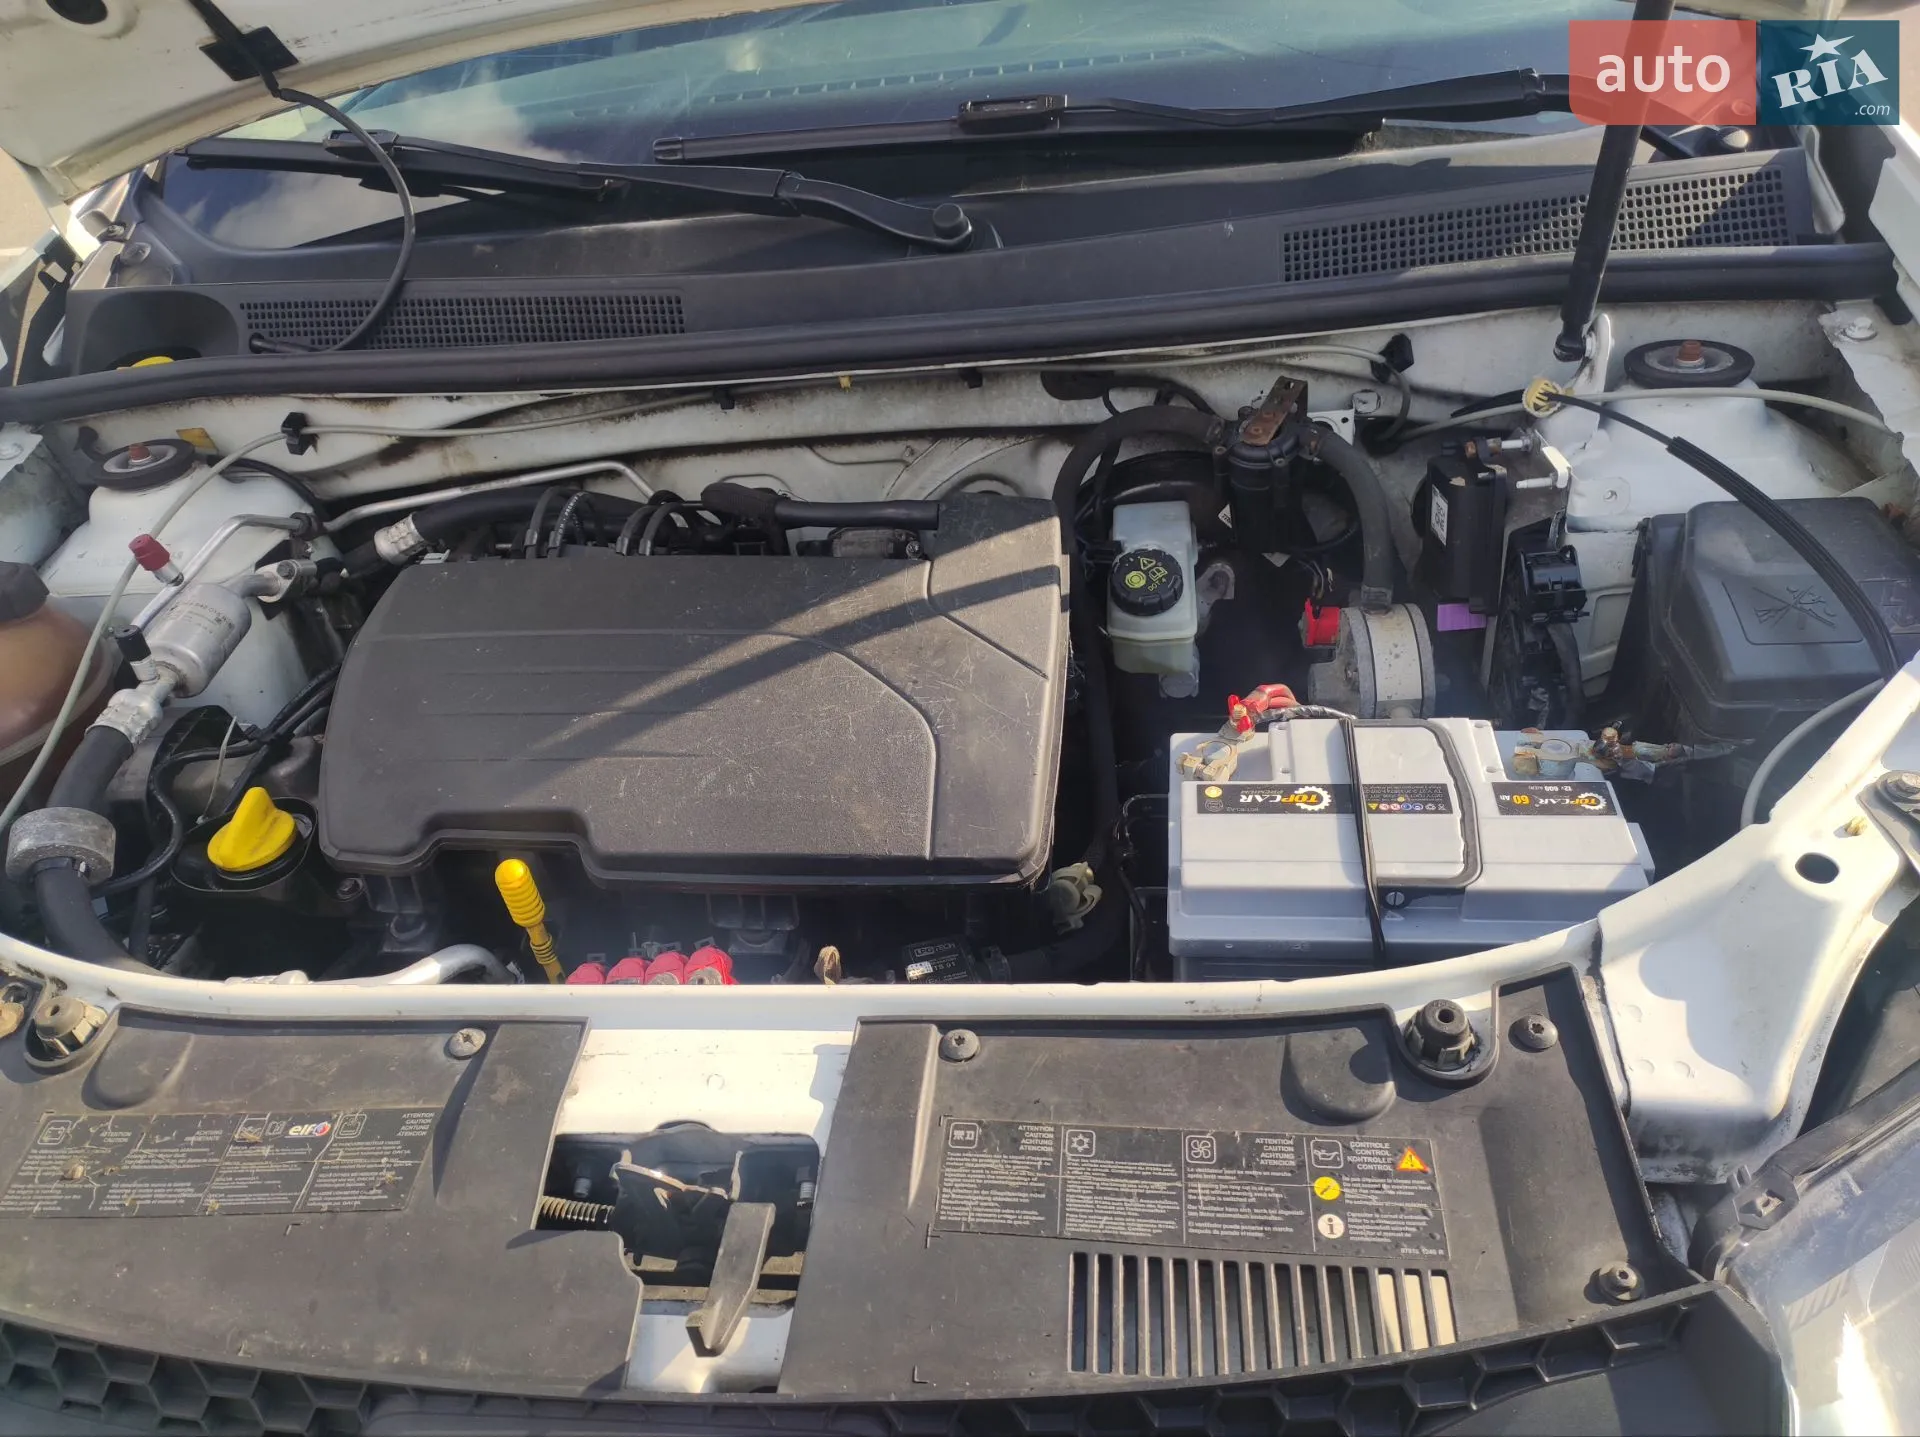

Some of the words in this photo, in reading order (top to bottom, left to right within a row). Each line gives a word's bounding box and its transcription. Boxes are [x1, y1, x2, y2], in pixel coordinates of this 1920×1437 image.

[1146, 580, 1161, 592] DOT
[1239, 793, 1320, 805] TOPCAR
[1512, 794, 1531, 806] 60
[288, 1123, 317, 1136] elf
[1018, 1124, 1054, 1132] ATTENTION
[1024, 1131, 1054, 1139] CAUTION
[1255, 1137, 1294, 1145] ATTENTION
[1355, 1149, 1391, 1157] CONTROL
[1346, 1155, 1393, 1163] KONTROLLE
[1357, 1163, 1392, 1171] CONTROL
